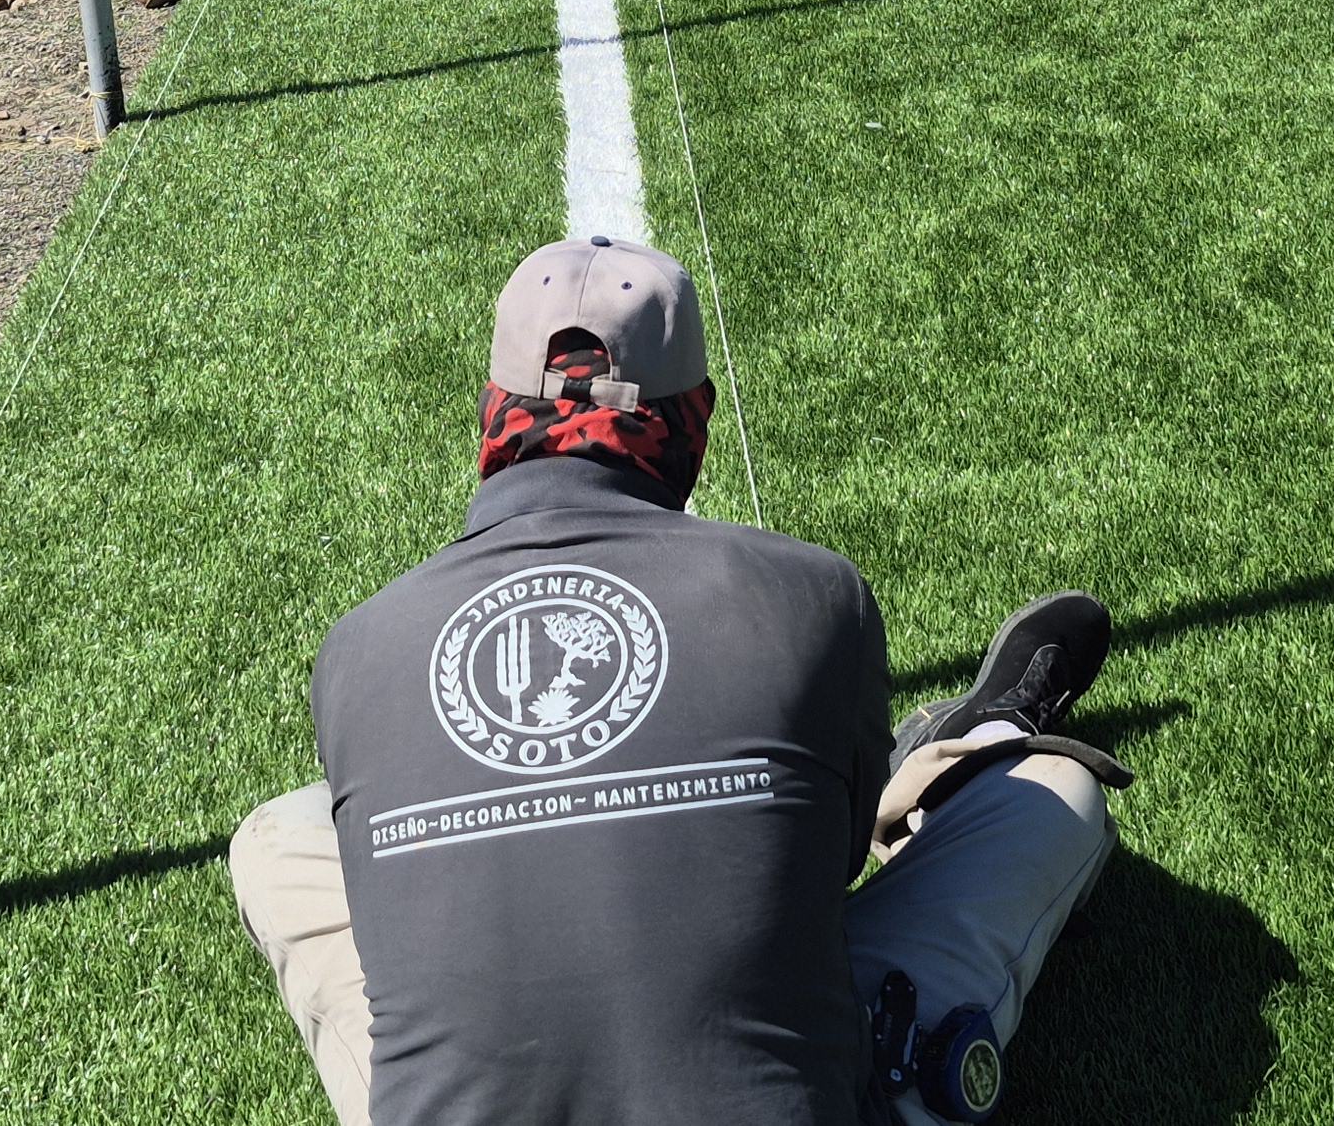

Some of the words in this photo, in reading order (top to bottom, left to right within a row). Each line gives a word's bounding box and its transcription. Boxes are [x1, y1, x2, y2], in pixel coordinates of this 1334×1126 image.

[466, 576, 624, 623] JARDINERIA
[485, 719, 611, 766] SOTO
[594, 772, 772, 808] MANTENIMIENTO
